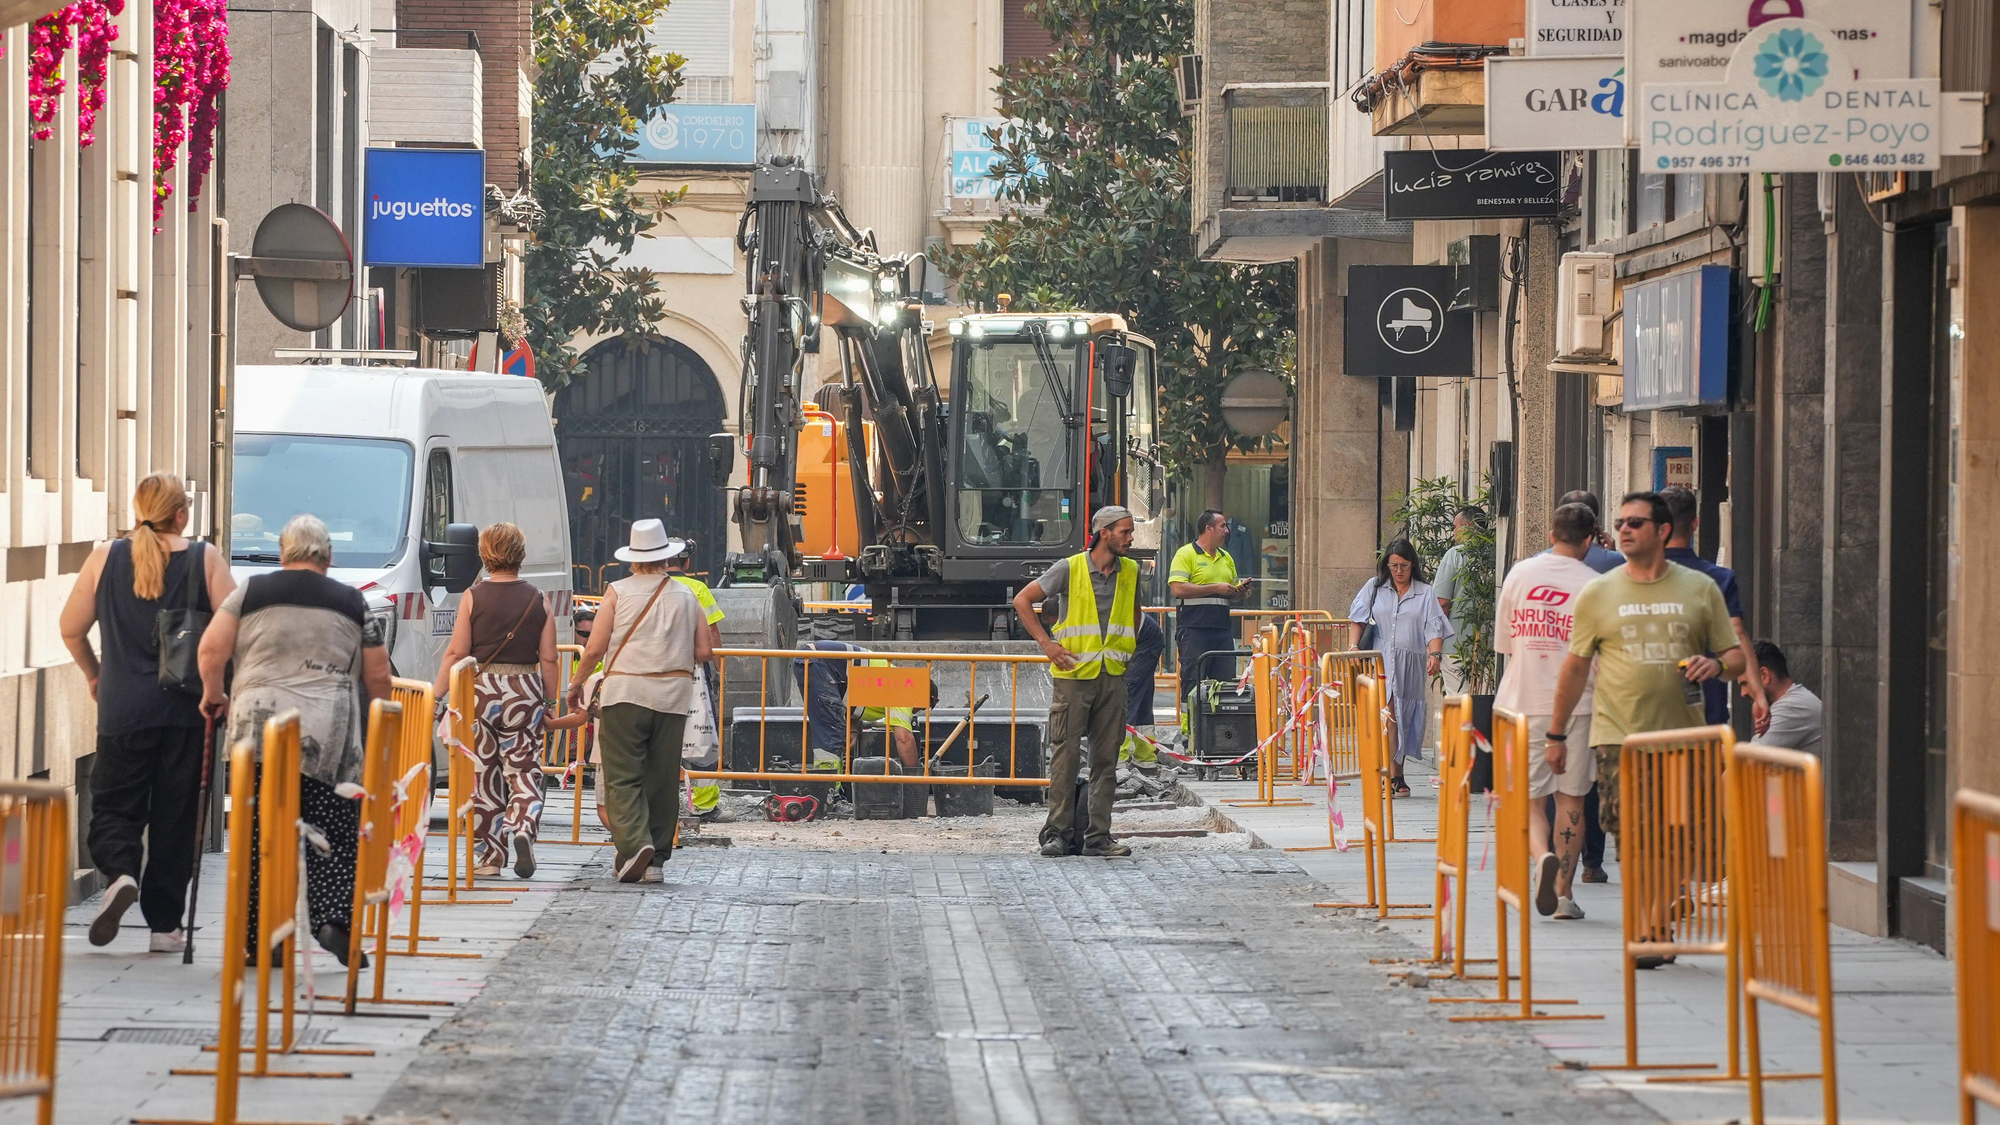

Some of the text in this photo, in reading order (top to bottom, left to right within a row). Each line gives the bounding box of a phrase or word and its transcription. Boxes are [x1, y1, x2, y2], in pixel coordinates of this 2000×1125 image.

[1606, 11, 1616, 24] Y
[1537, 28, 1623, 42] SEGURIDAD
[1689, 28, 1752, 47] magda
[1650, 90, 1931, 112] CLÍNICA DENTAL
[682, 116, 744, 126] CORDELRIO
[682, 128, 745, 150] 1970
[1651, 117, 1930, 151] Rodríguez-Poyo
[1671, 156, 1750, 168] 957 496 371
[1845, 153, 1925, 166] 646 403 482
[955, 179, 983, 194] 957
[372, 195, 473, 220] juguettos
[1618, 603, 1648, 617] CALL
[1650, 602, 1684, 615] DUTY
